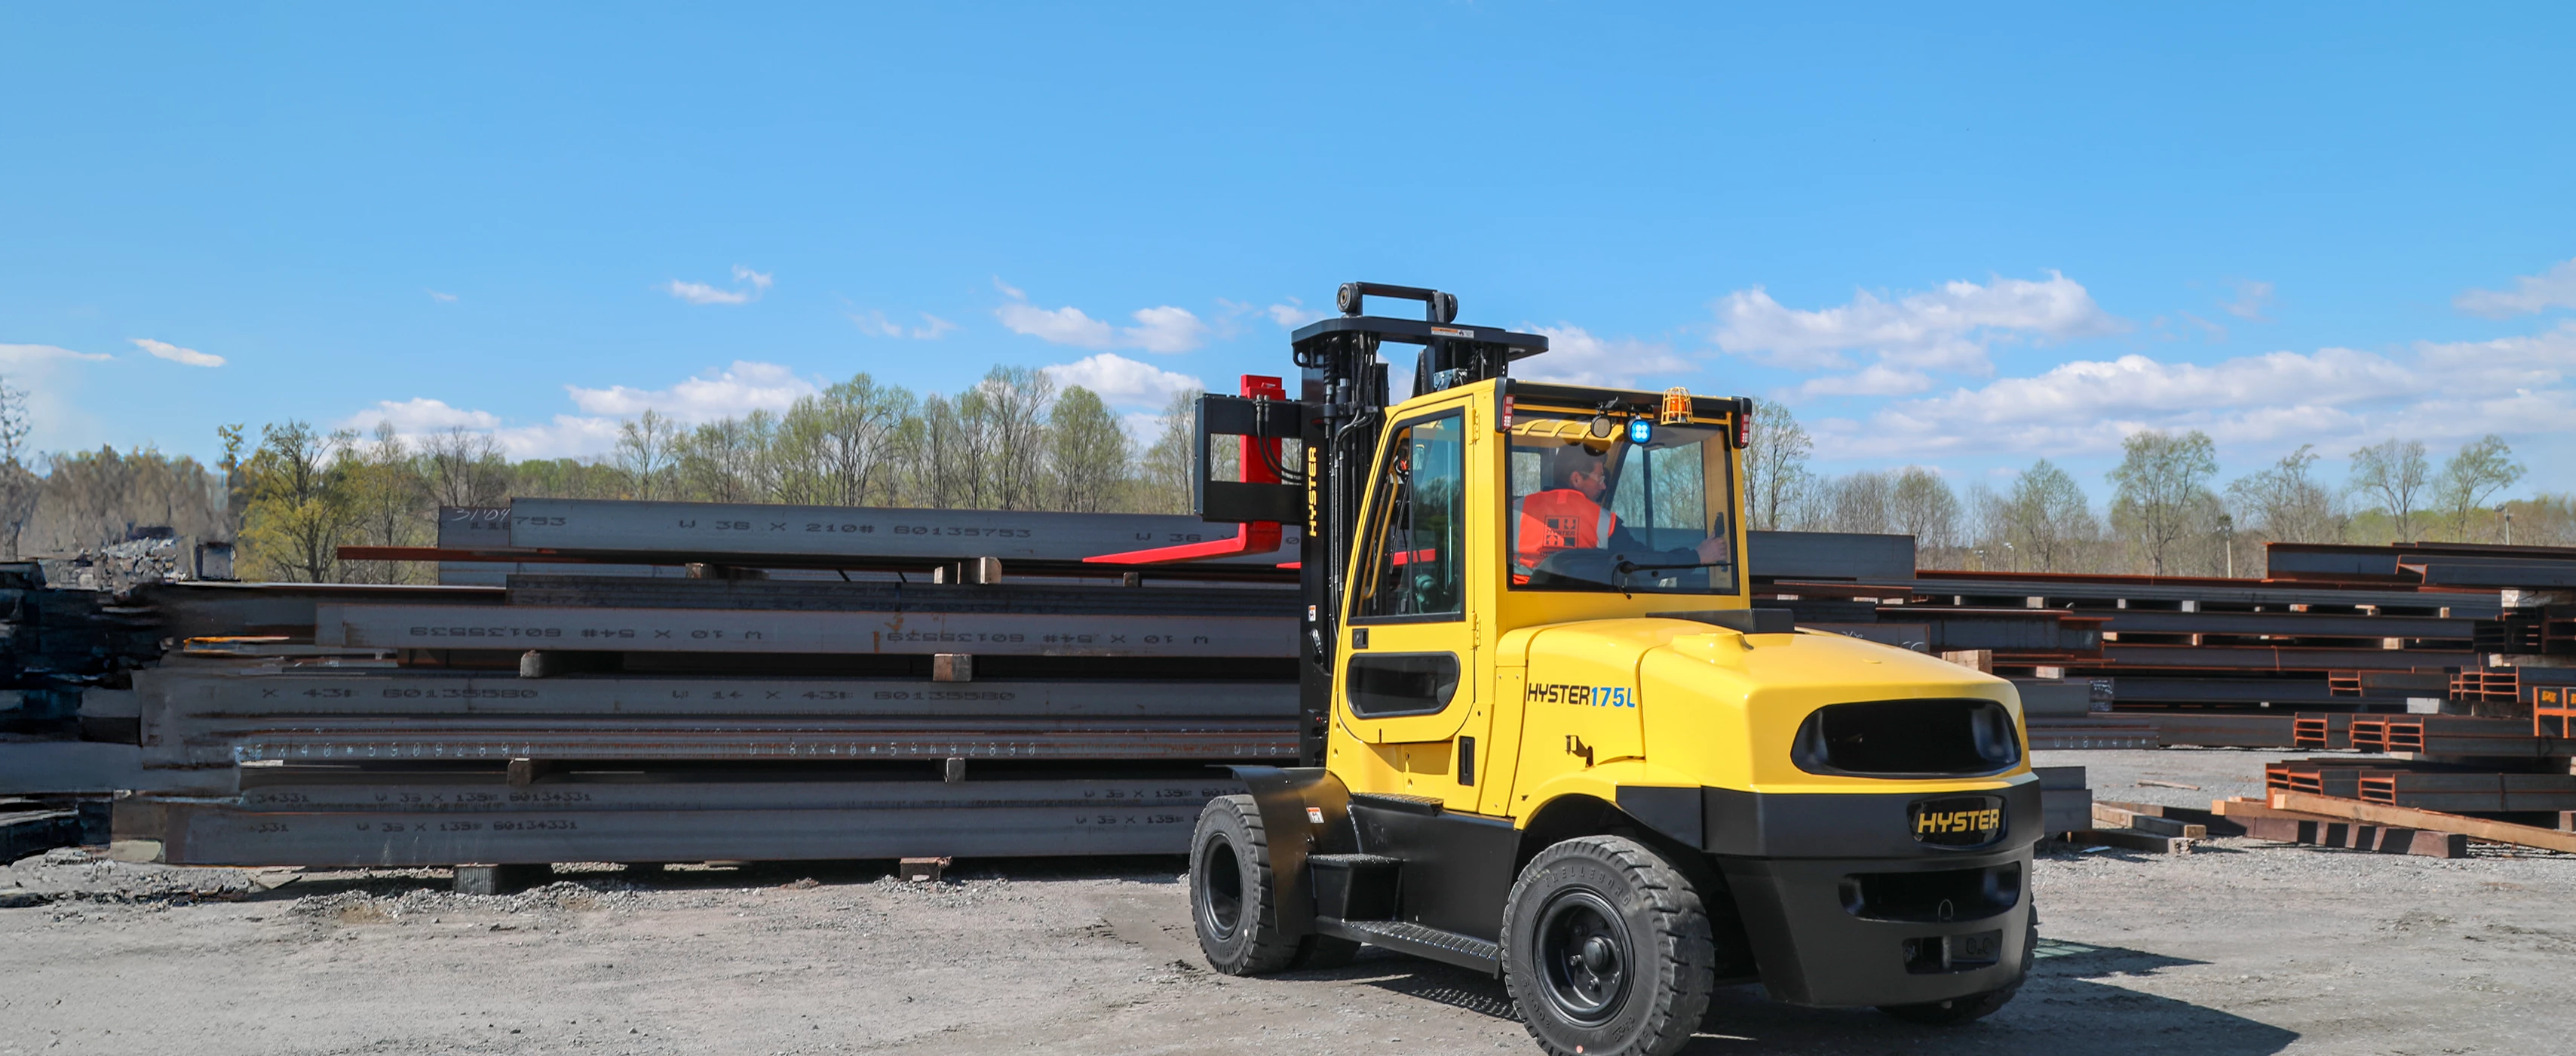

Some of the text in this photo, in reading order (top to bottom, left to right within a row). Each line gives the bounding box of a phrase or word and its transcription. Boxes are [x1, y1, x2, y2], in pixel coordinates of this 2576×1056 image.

[1308, 447, 1317, 537] HYSTER
[679, 520, 696, 529] W
[770, 522, 787, 531] X
[806, 523, 875, 533] 210#
[1136, 532, 1201, 542] W 36
[655, 629, 670, 639] X
[1111, 634, 1125, 643] X
[765, 690, 782, 700] X
[431, 794, 443, 803] X
[1133, 789, 1144, 798] X
[1125, 815, 1136, 824] X
[1918, 809, 2000, 833] HYSTER
[415, 822, 427, 831] X
[1543, 866, 1631, 905] TRELLEBORG
